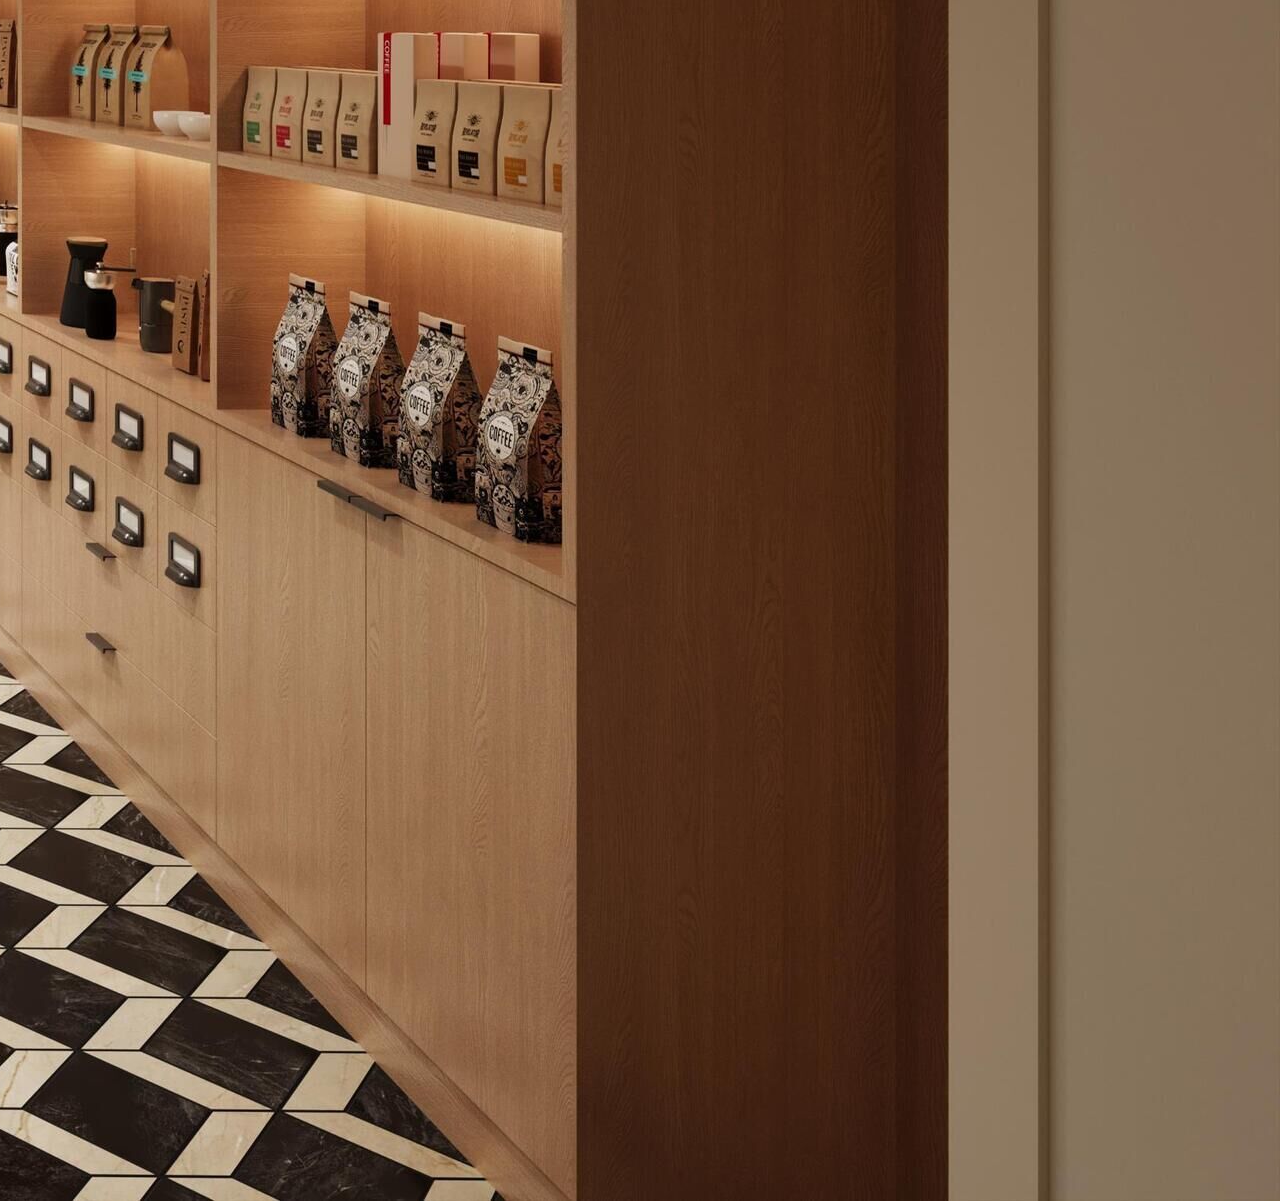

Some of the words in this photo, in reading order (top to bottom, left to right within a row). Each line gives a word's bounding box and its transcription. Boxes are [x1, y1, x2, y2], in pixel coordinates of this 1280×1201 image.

[280, 344, 296, 363] COFFEE
[341, 367, 359, 388] COFFEE
[409, 394, 430, 416] COFFEE
[489, 424, 514, 449] COFFEE
